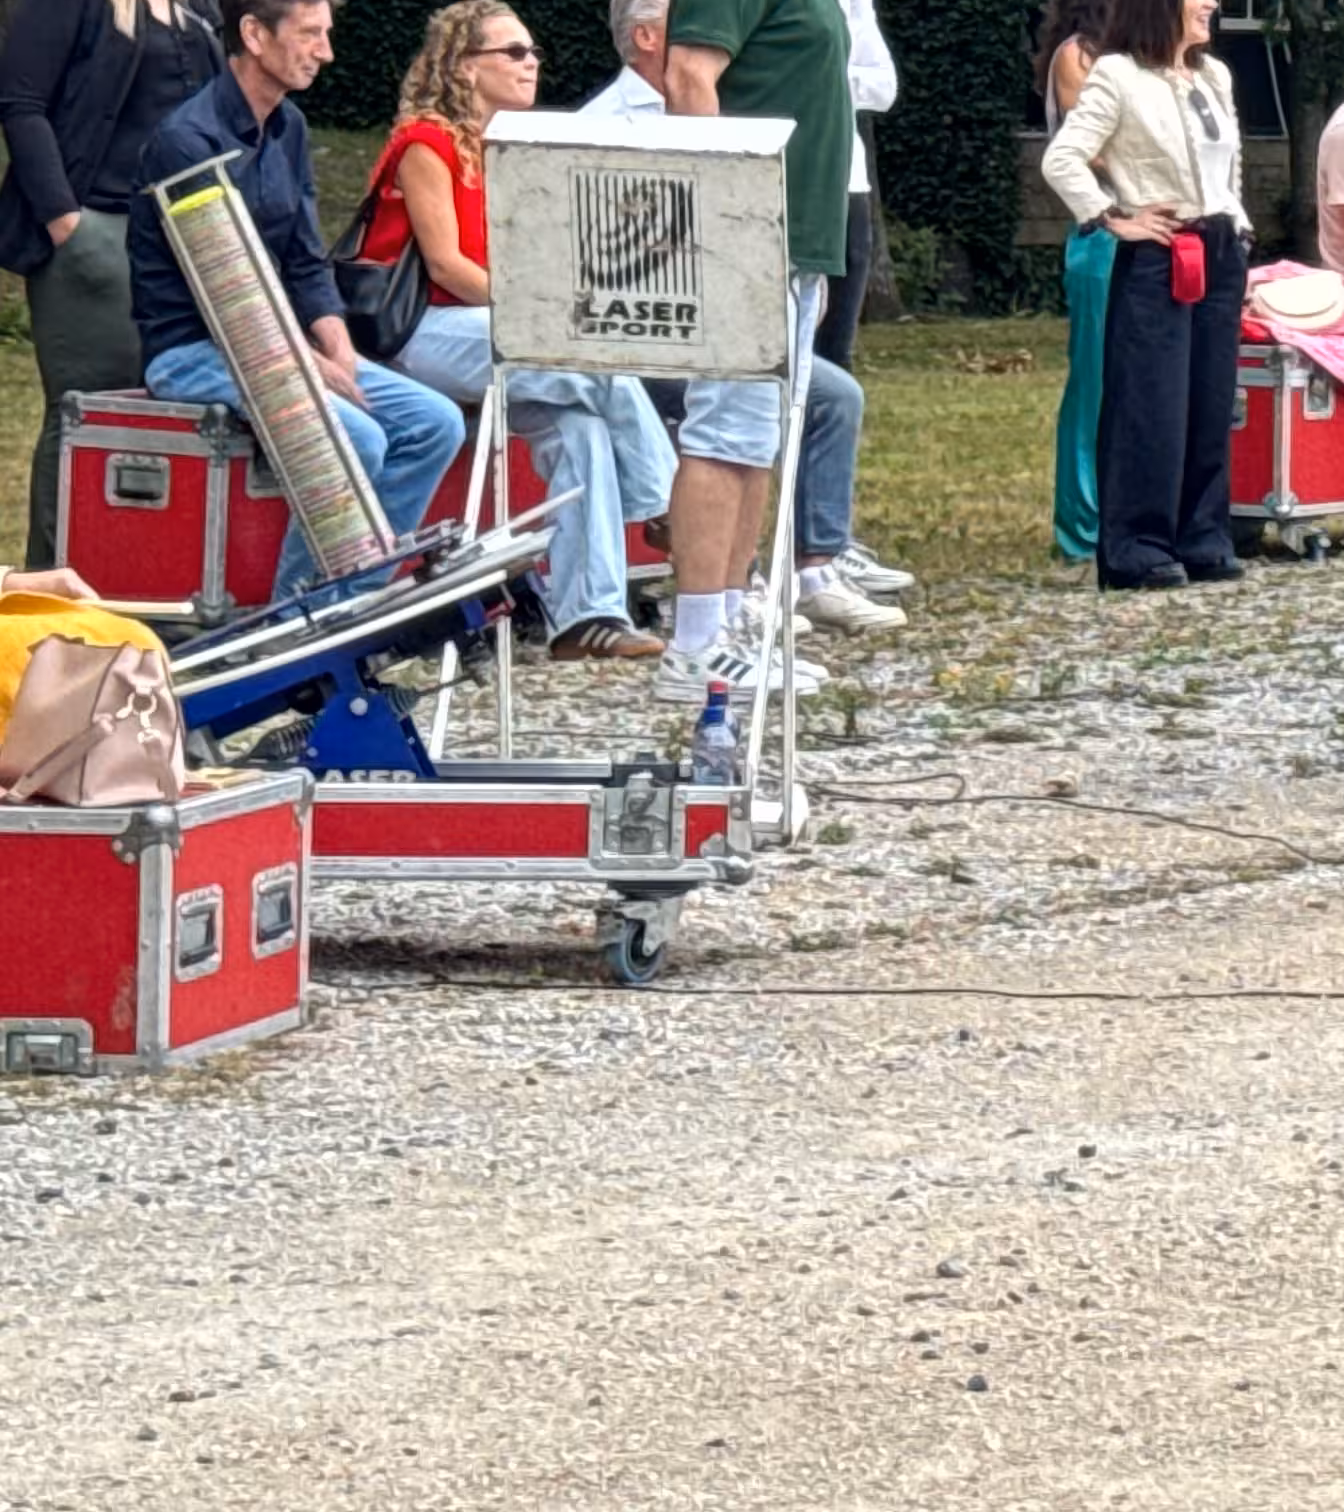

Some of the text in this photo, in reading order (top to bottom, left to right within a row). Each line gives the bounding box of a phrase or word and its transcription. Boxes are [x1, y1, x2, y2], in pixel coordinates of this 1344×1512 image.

[582, 298, 697, 324] LASER
[581, 320, 697, 340] SPORT
[322, 768, 417, 783] ASER
